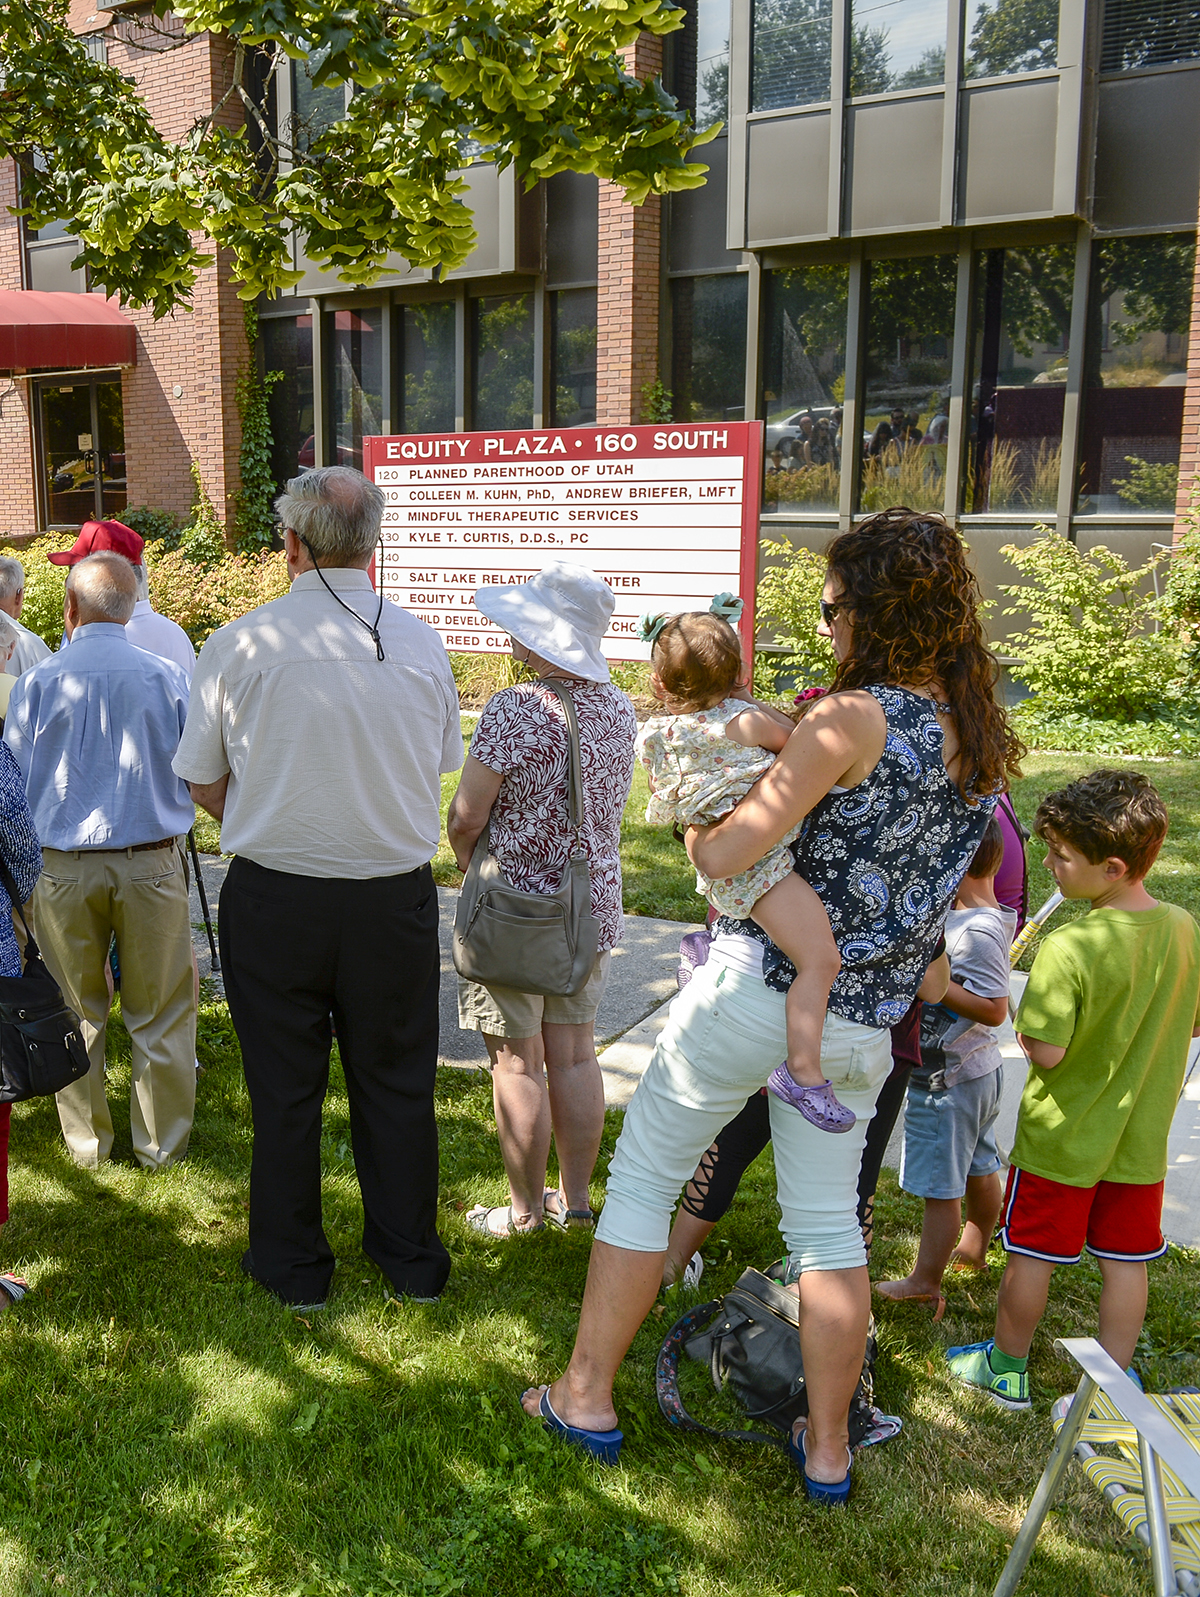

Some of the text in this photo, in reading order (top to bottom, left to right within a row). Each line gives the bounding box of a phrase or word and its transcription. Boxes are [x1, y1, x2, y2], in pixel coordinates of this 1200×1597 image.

[386, 430, 729, 459] EQUITY PLAZA 160 SOUTH
[378, 464, 634, 480] 120 PLANNED PARENTHOOD OF UTAH
[384, 486, 737, 502] 10 COLLEEN M. KUHN, PhD, ANDREW BRIEFER, LMFT
[407, 511, 462, 522] MINDFUL
[468, 511, 560, 522] THERAPEUTIC
[568, 510, 639, 521] SERVICES
[379, 532, 589, 545] 230 KYLE T. CURTIS, D.D.S., PC
[378, 552, 400, 562] 240
[409, 572, 438, 583] SALT
[443, 573, 476, 584] LAKE
[601, 576, 641, 587] NTER
[409, 593, 455, 604] EQUITY
[412, 614, 440, 625] HILD
[446, 635, 480, 646] REED
